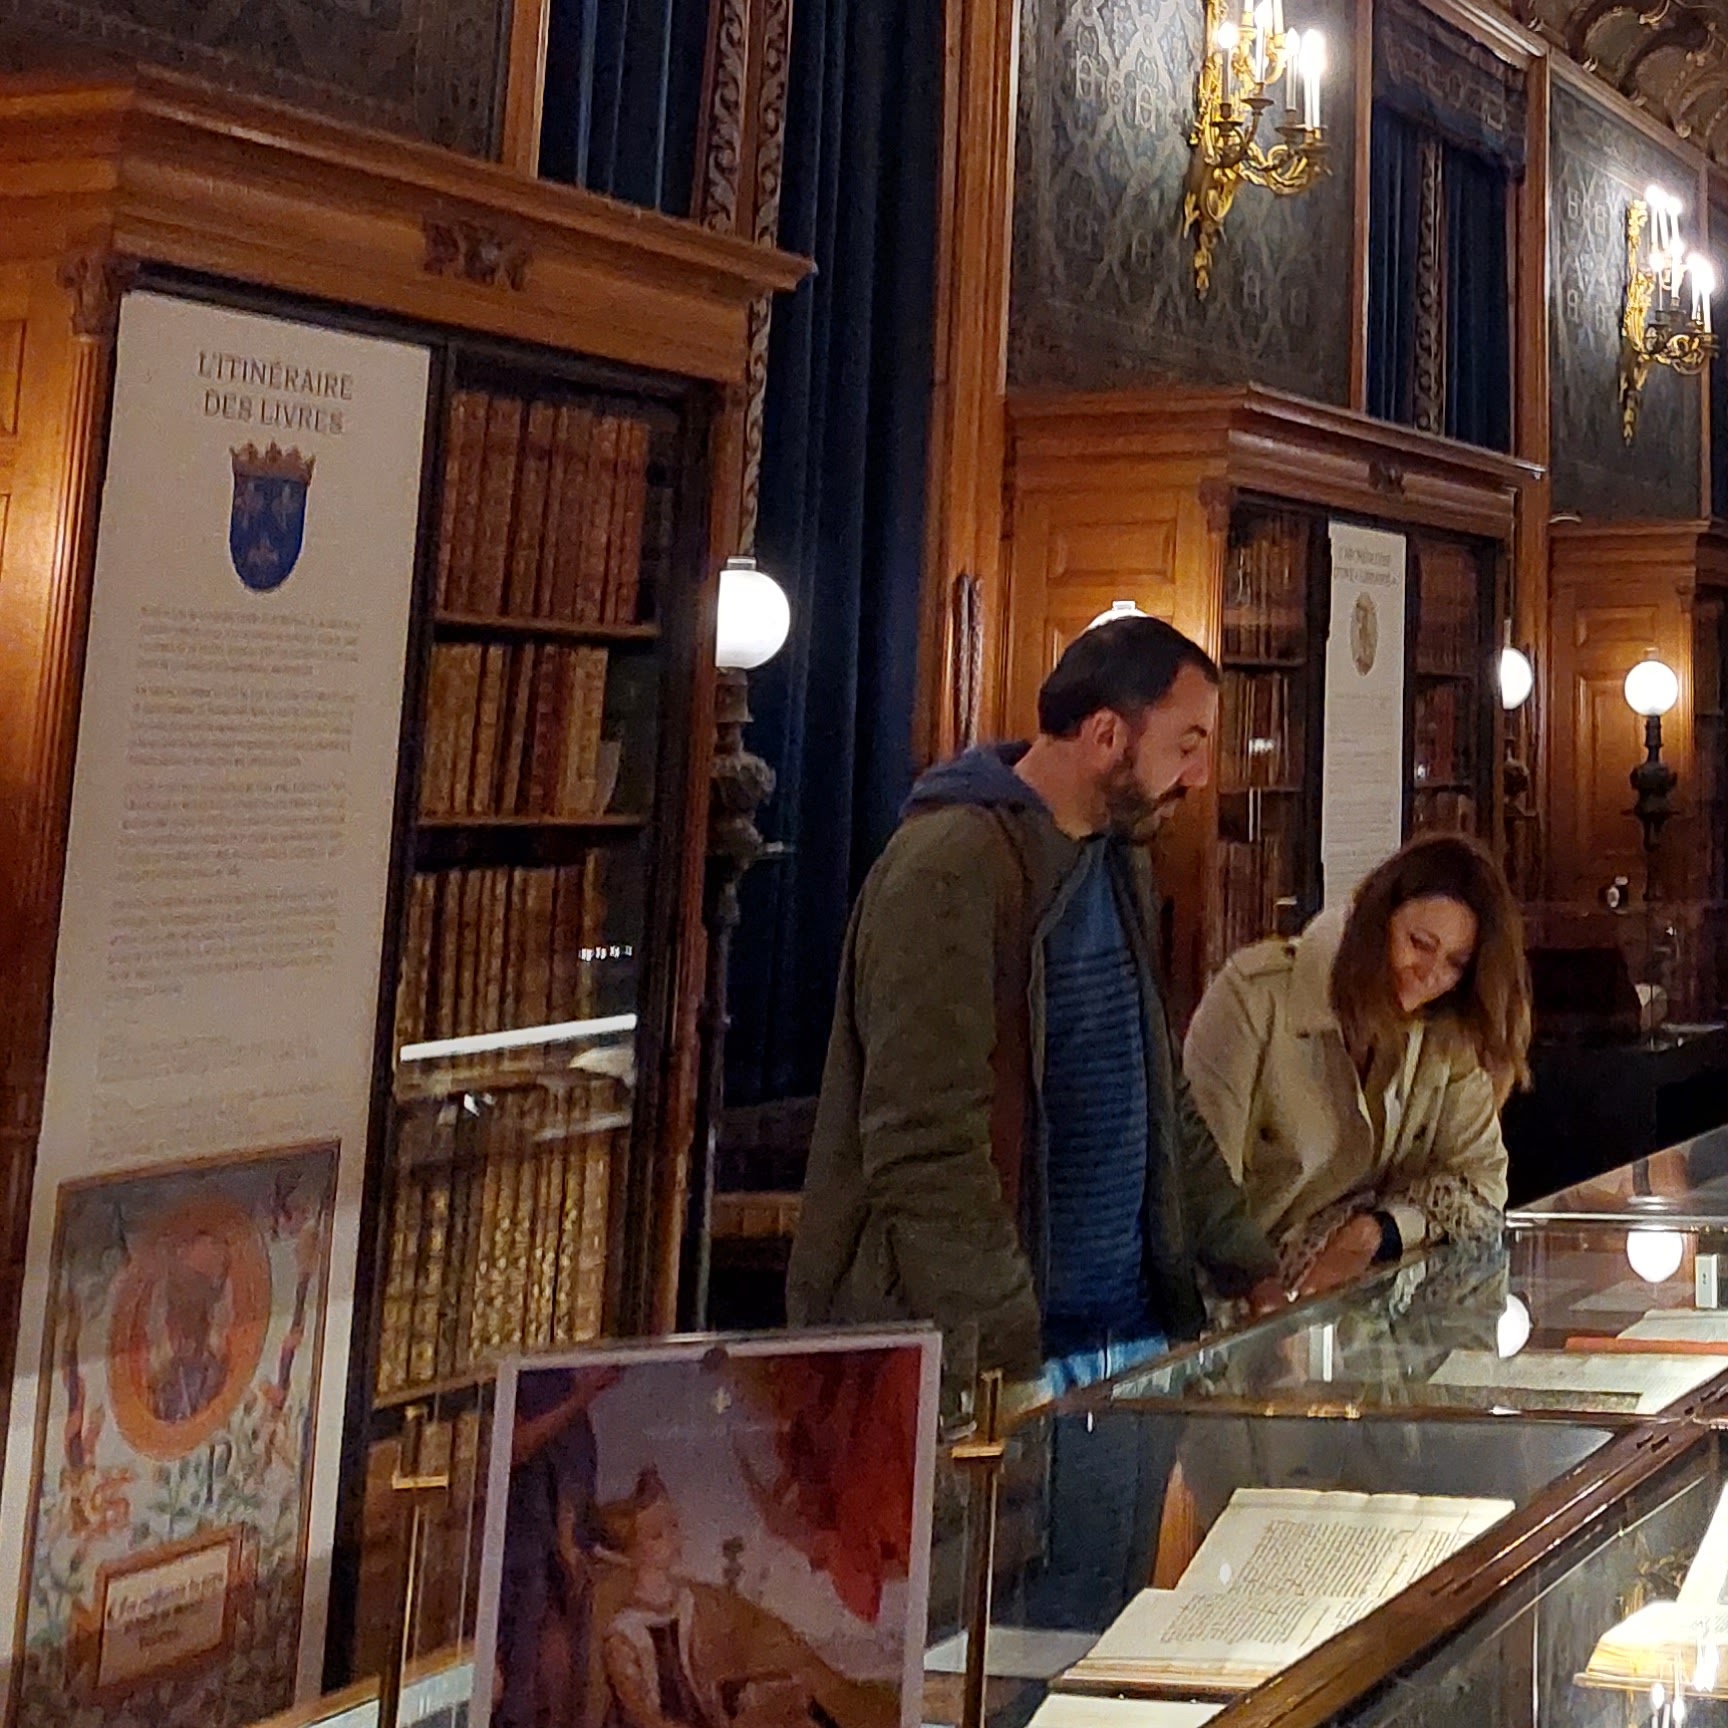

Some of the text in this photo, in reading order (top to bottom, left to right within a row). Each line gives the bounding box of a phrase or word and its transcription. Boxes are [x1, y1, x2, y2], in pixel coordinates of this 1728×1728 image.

[198, 350, 354, 401] L'ITINÉRAIRE
[204, 387, 345, 435] DES LIVRES
